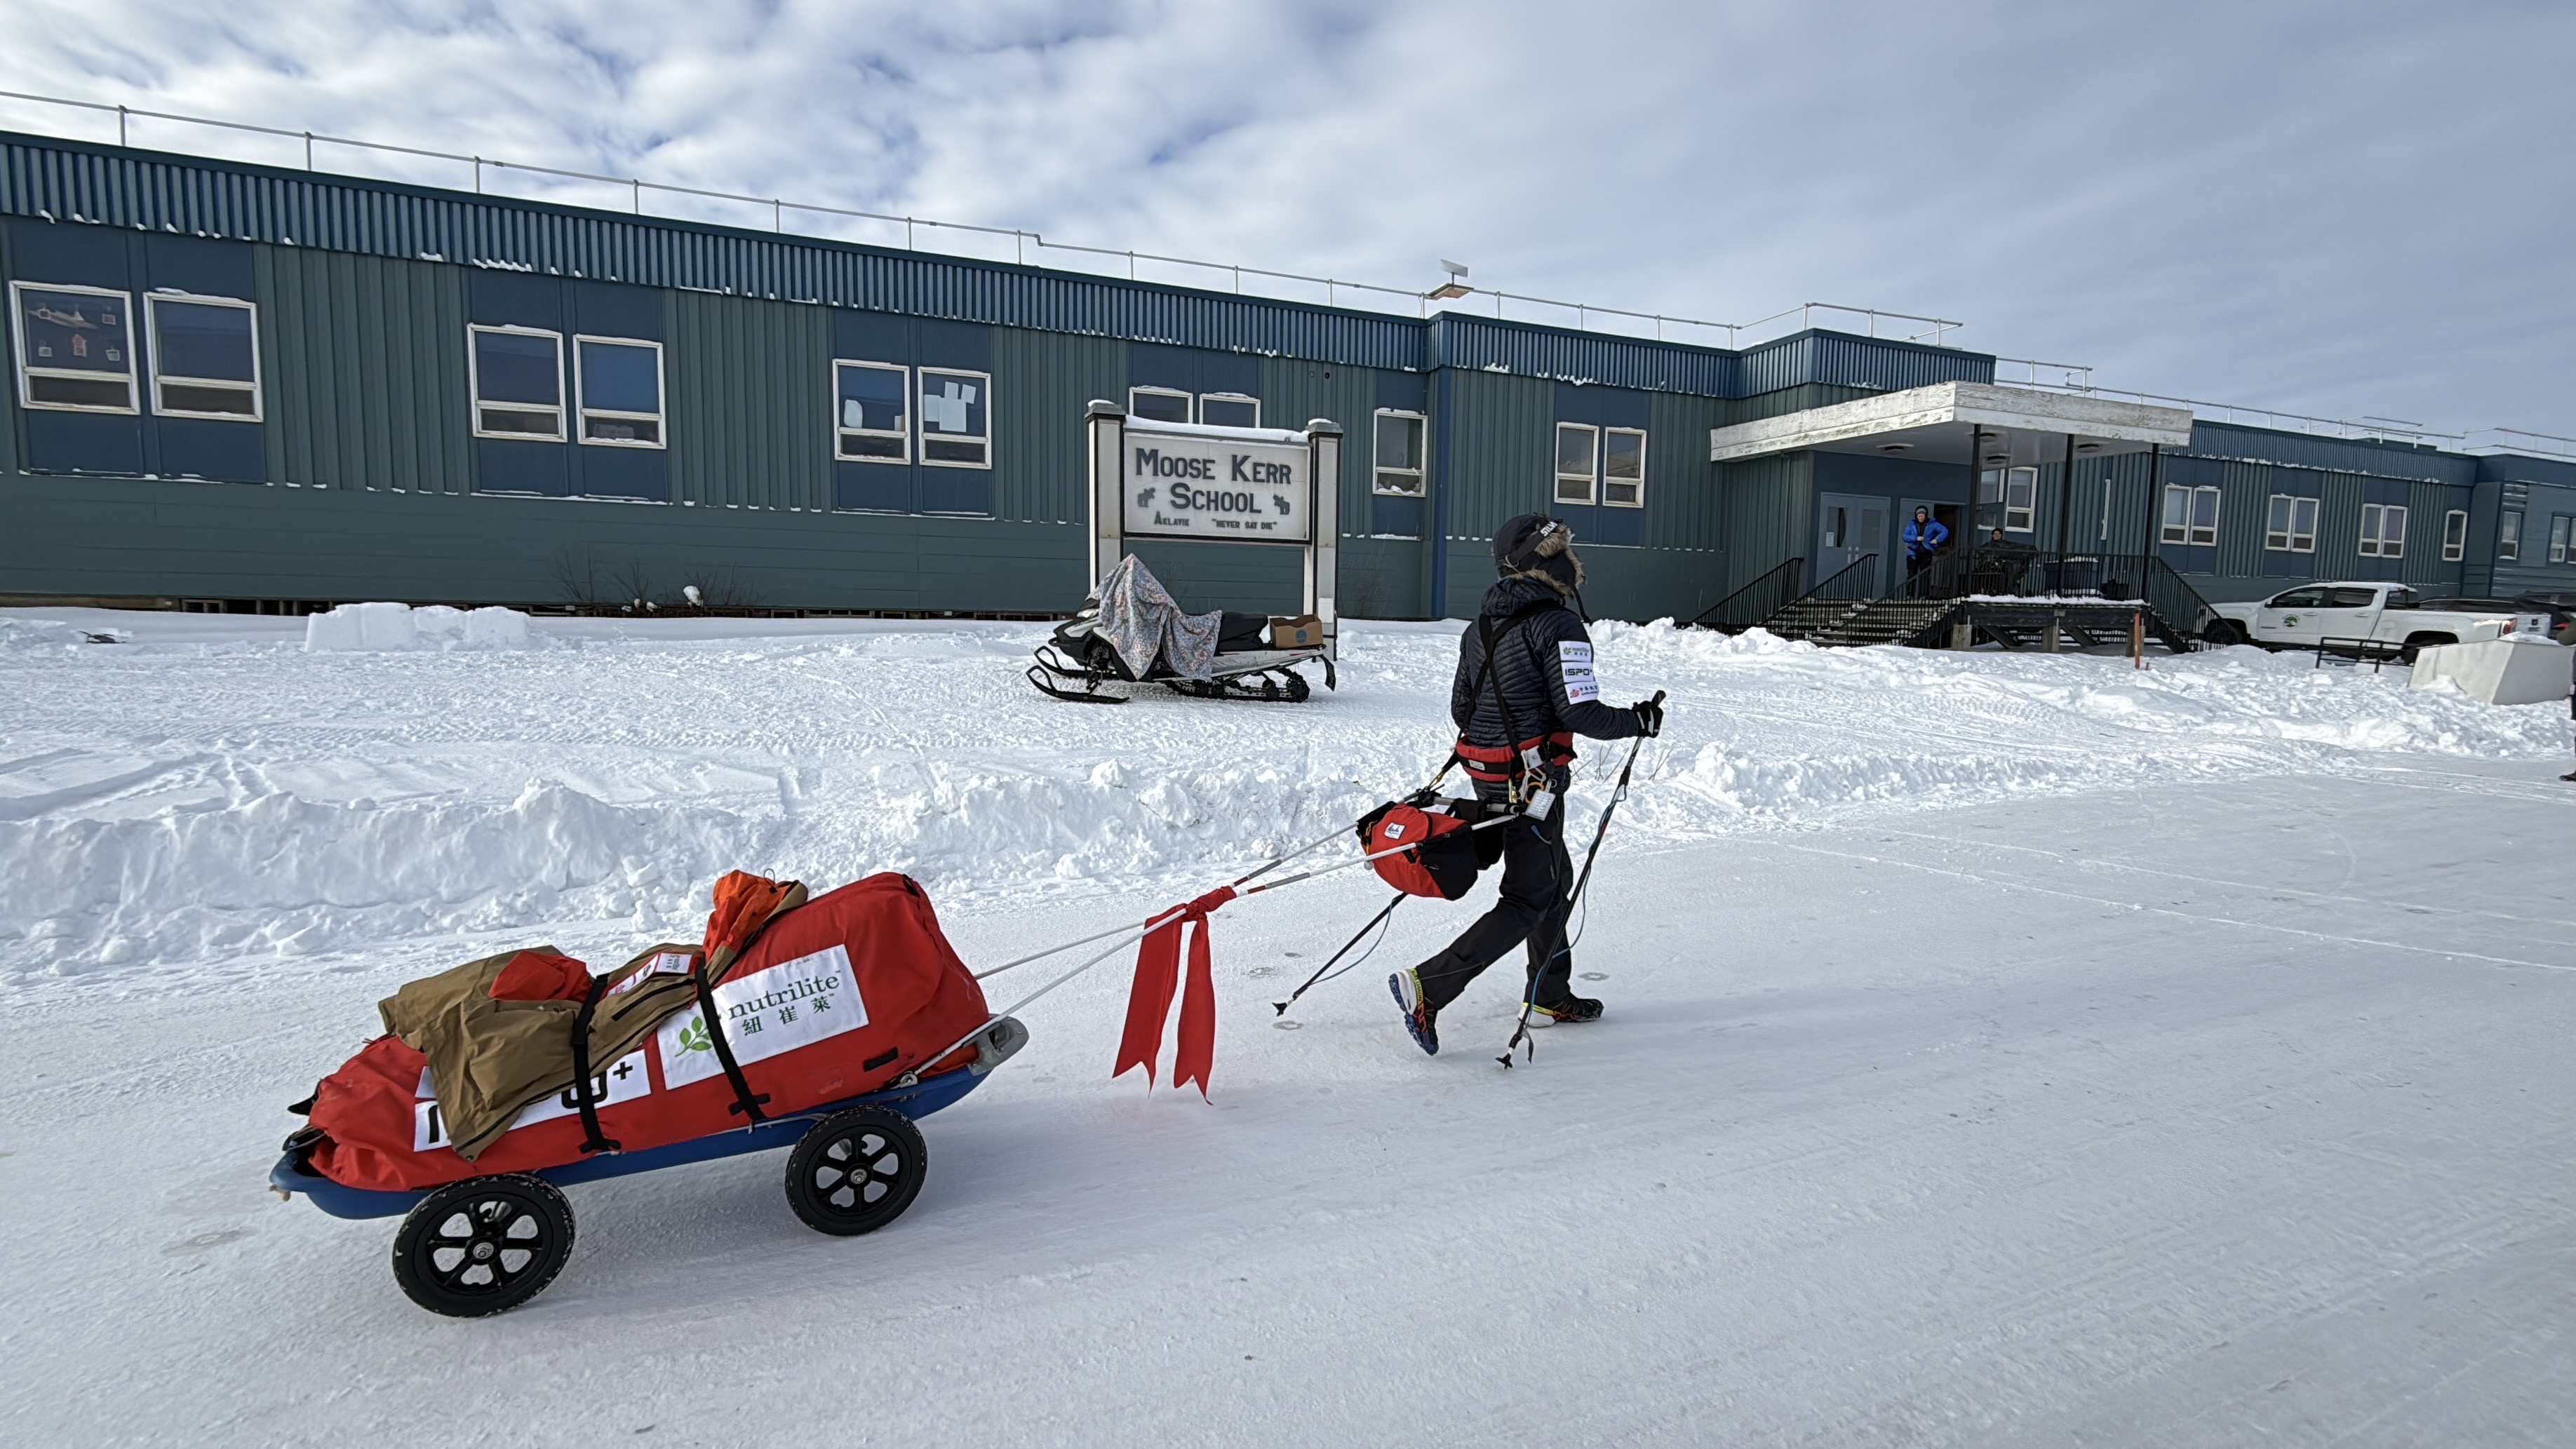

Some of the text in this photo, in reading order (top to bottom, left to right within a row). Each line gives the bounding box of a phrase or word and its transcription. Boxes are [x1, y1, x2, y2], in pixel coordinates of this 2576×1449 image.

[1136, 447, 1292, 485] MOOSE KERR
[1170, 483, 1262, 513] SCHOOL
[1154, 511, 1190, 526] AKLAVIK
[1245, 521, 1258, 530] SAY
